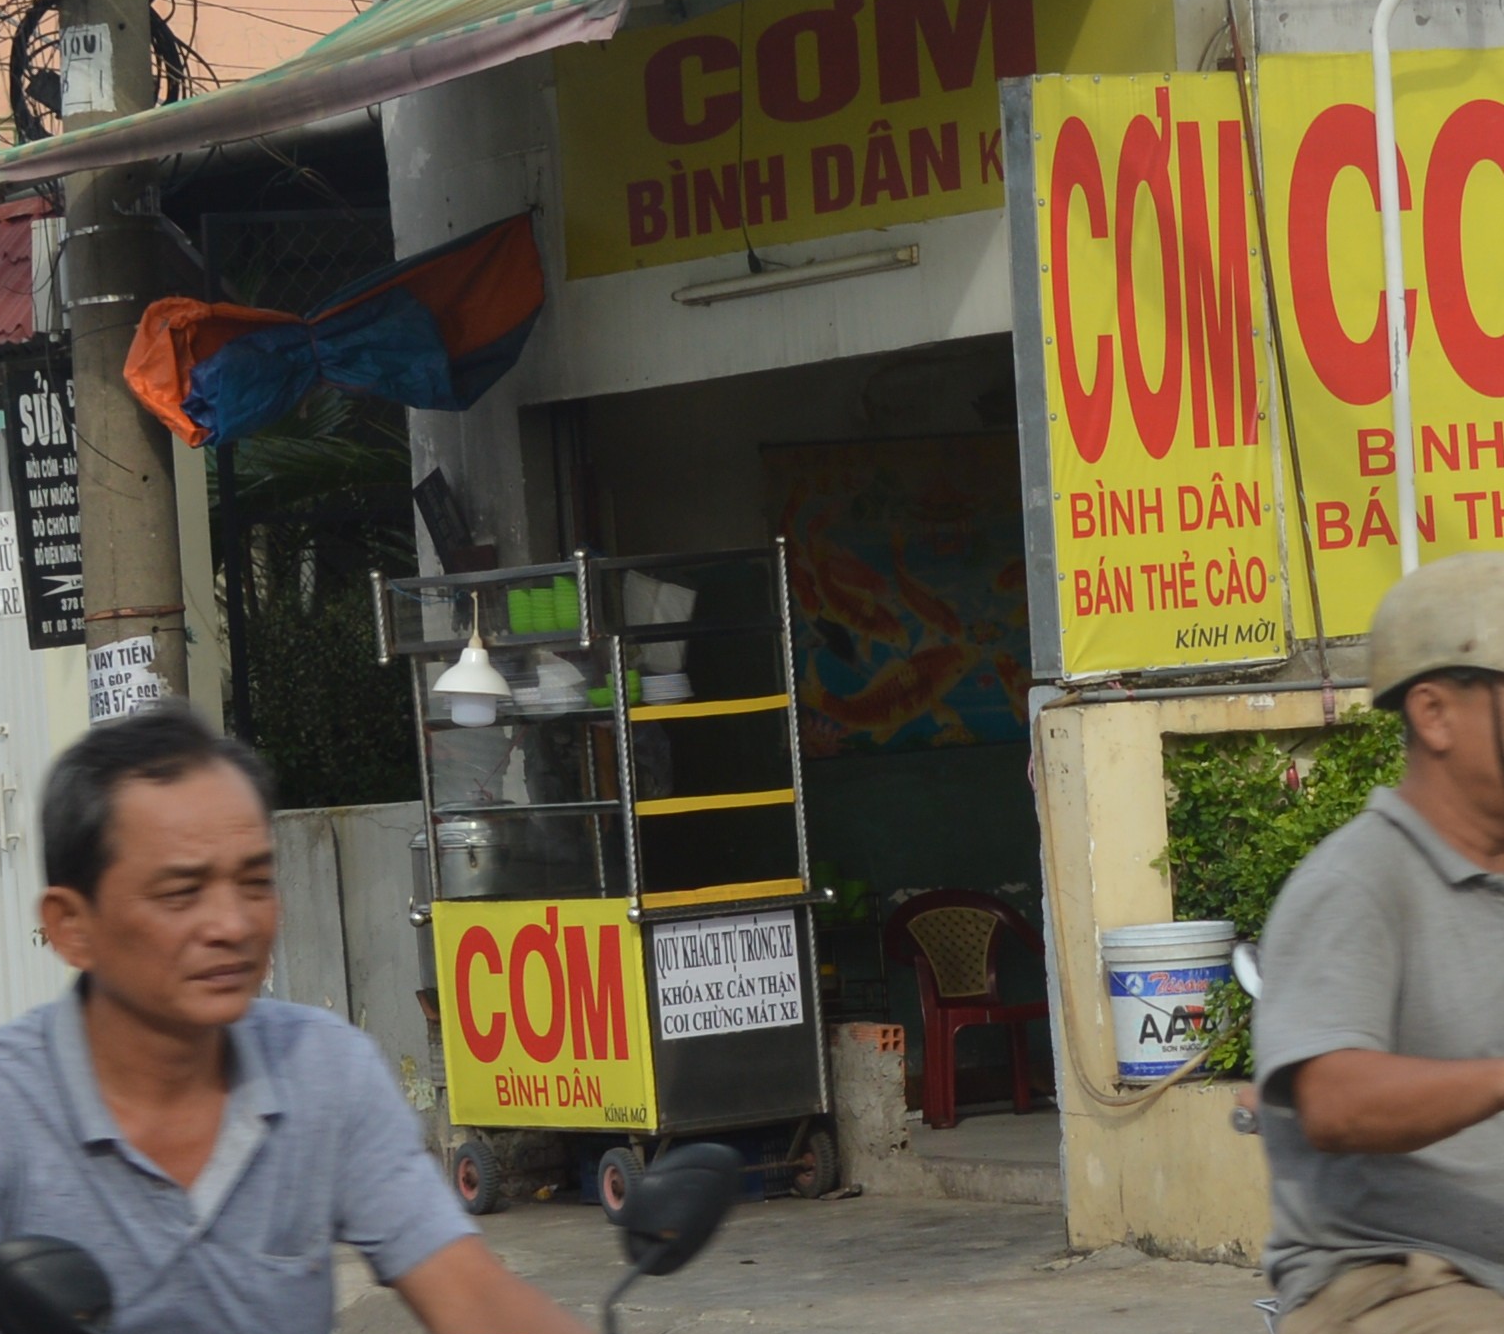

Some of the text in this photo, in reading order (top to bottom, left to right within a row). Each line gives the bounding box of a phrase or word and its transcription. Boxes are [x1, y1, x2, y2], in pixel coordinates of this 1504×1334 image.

[626, 152, 789, 248] BÌNH
[811, 118, 963, 216] DÂN
[1050, 86, 1260, 465] CƠM
[18, 370, 68, 447] SỬA
[1069, 471, 1263, 540] BÌNH DÂN
[1315, 486, 1437, 551] BÁN
[1073, 546, 1268, 618] BÁN THẺ CÀO
[1175, 617, 1277, 650] KÍNH MỜI
[681, 922, 722, 969] KHÁCH
[738, 916, 777, 963] TRÔNG
[777, 924, 794, 958] XE
[455, 906, 629, 1064] CƠM
[661, 979, 703, 1007] KHÓA
[705, 981, 725, 1002] XE
[758, 971, 797, 998] THẬN
[663, 1013, 690, 1035] COI
[692, 1004, 743, 1031] CHỪNG
[781, 1000, 799, 1021] XE
[495, 1067, 603, 1108] BÌNH DÂN
[604, 1103, 628, 1124] KÍNH
